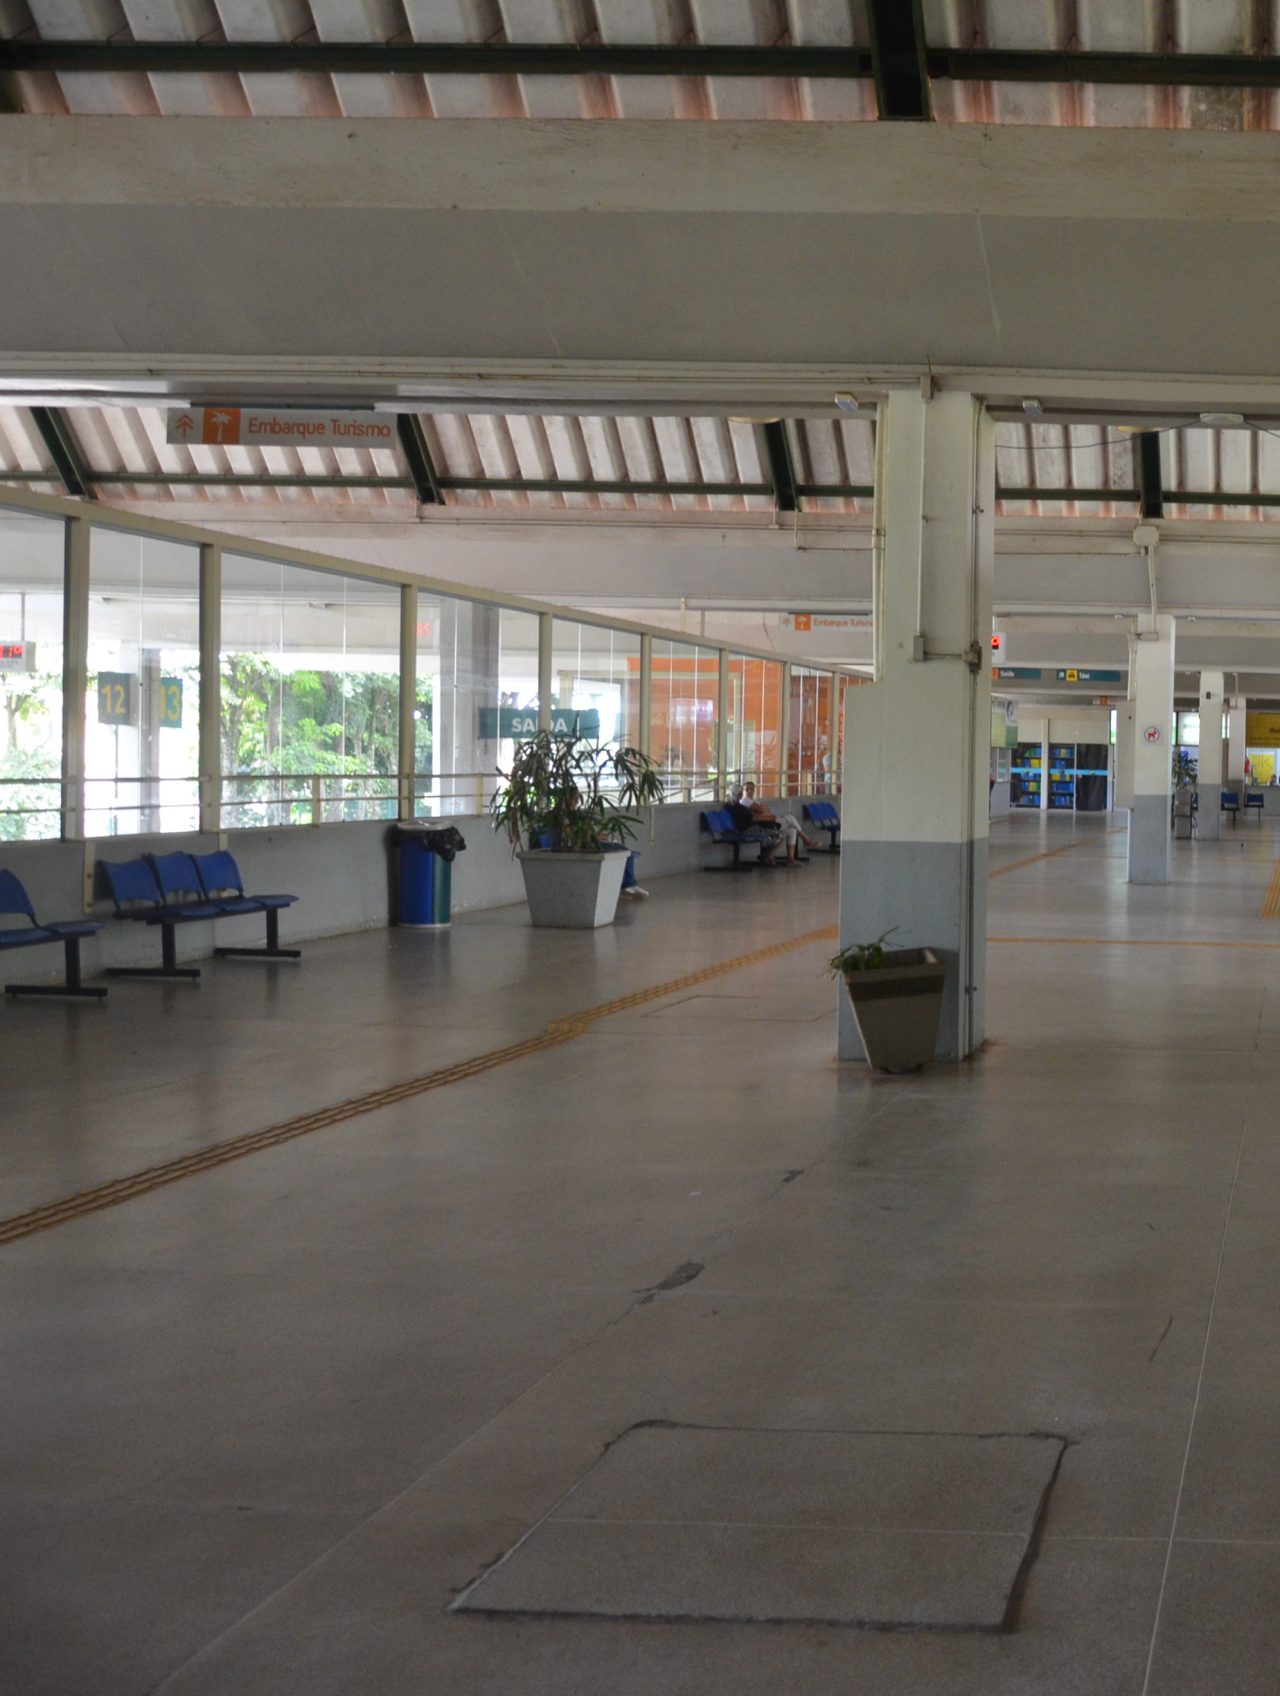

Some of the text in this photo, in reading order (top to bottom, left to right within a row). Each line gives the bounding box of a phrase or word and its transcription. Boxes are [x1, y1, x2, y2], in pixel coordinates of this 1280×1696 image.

[248, 417, 391, 439] Embarque Turismo
[101, 684, 126, 714] 12
